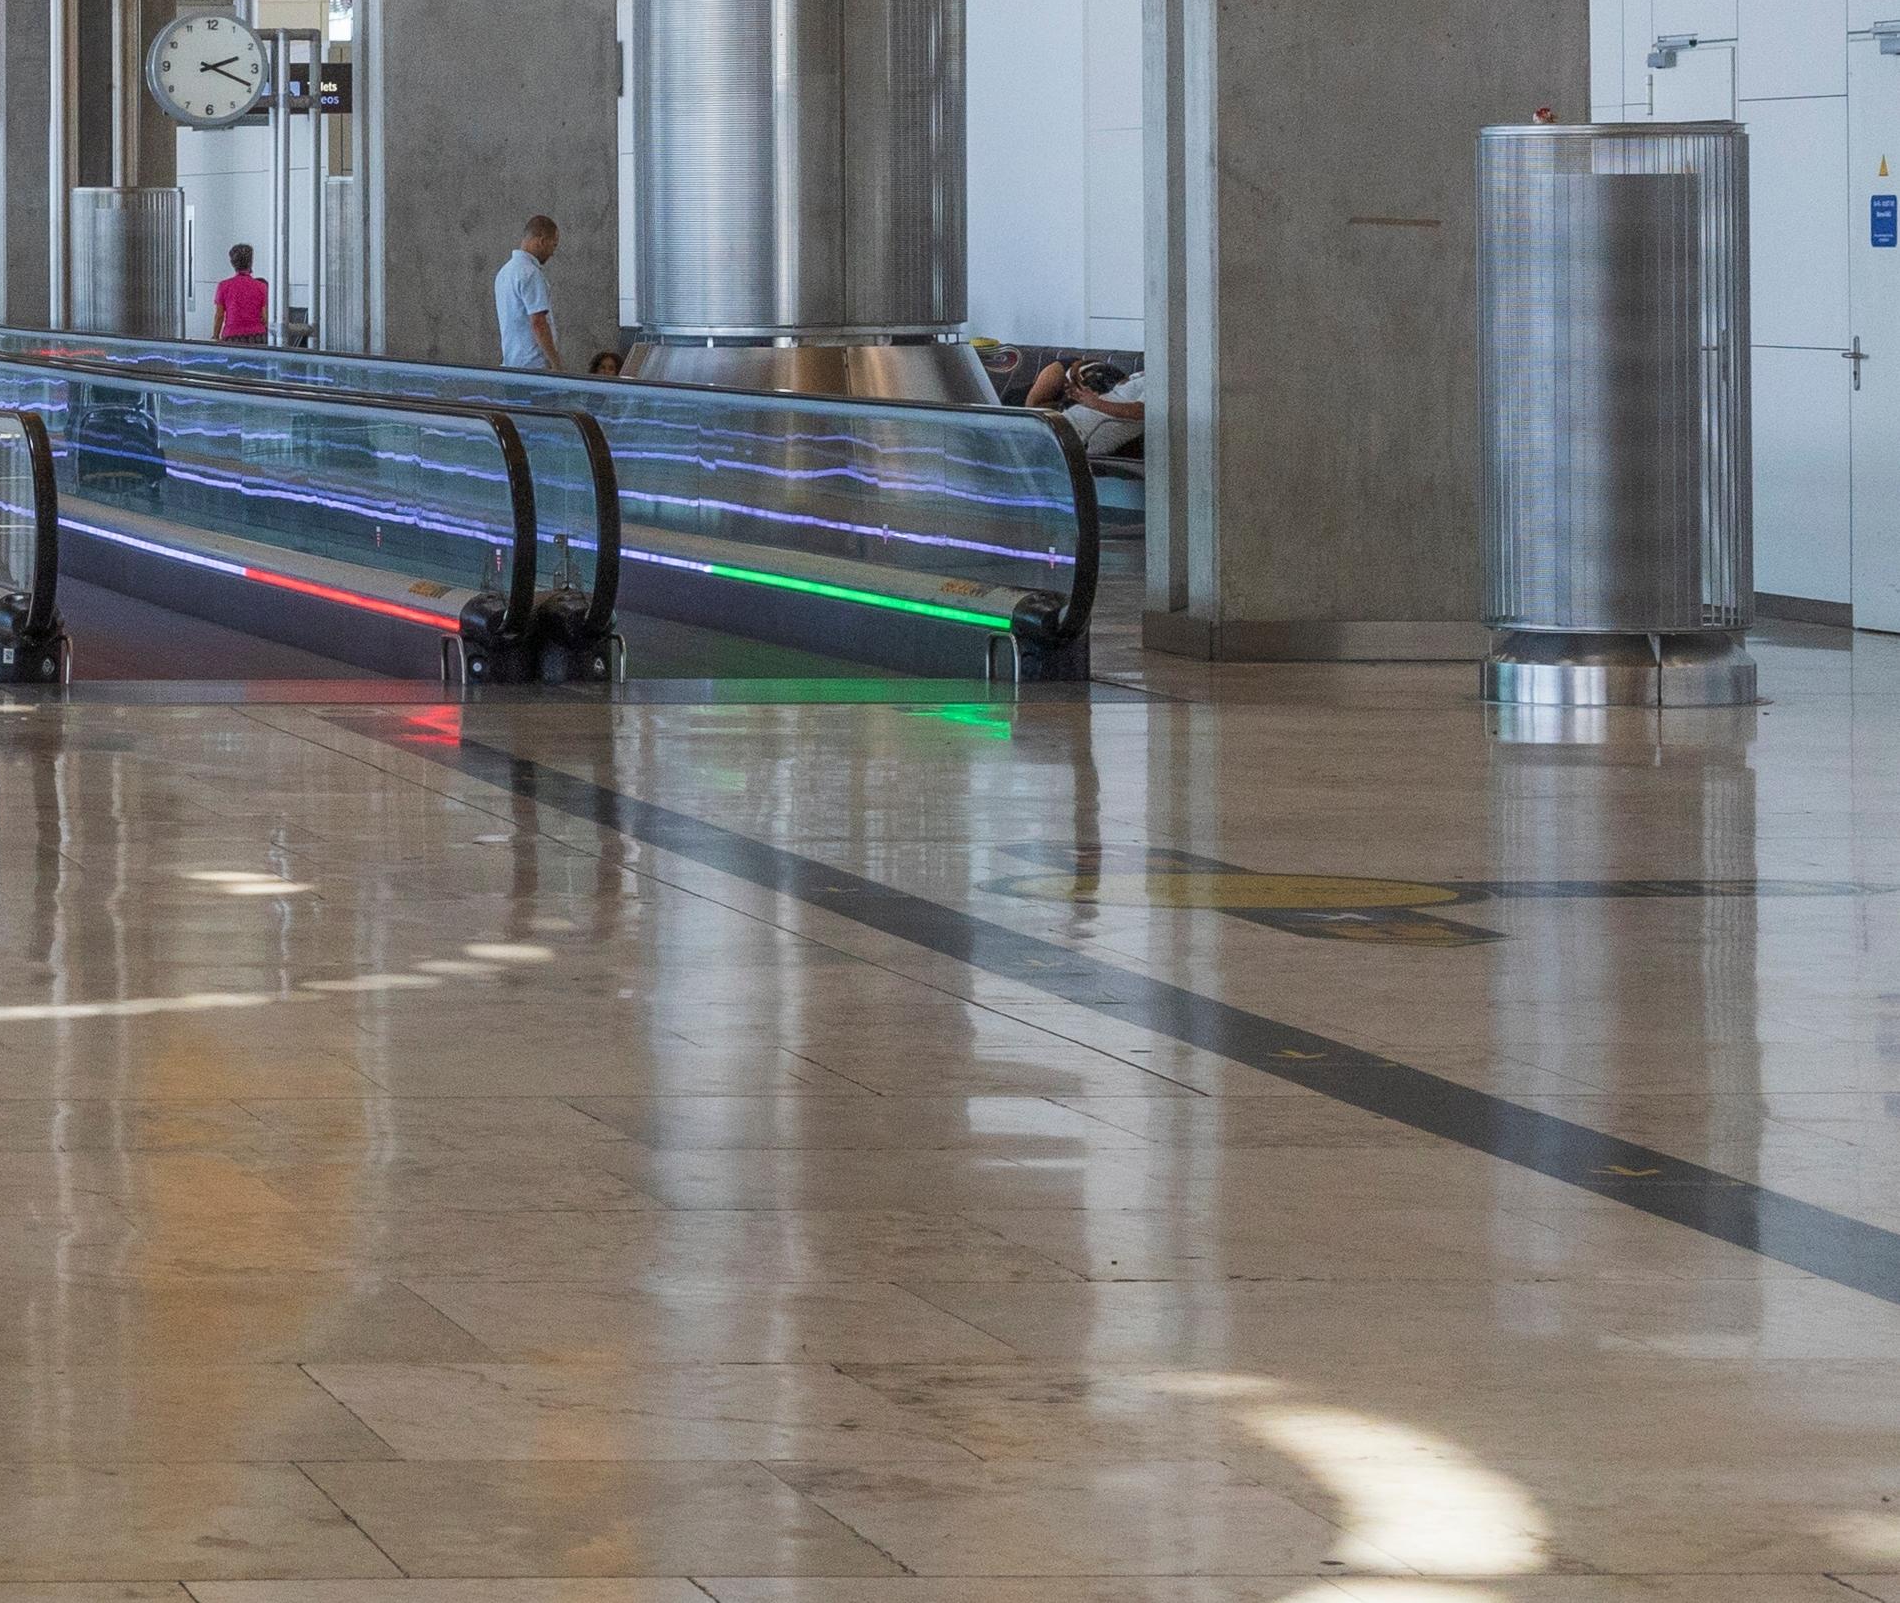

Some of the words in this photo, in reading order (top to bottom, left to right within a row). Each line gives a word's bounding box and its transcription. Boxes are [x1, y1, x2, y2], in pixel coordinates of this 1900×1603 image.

[186, 25, 193, 33] 11
[206, 20, 219, 31] 12
[170, 41, 179, 49] 10
[162, 61, 171, 72] 9
[250, 64, 259, 74] 3
[168, 85, 175, 93] 8
[230, 101, 236, 109] 5
[320, 95, 340, 105] eos
[205, 104, 214, 115] 6
